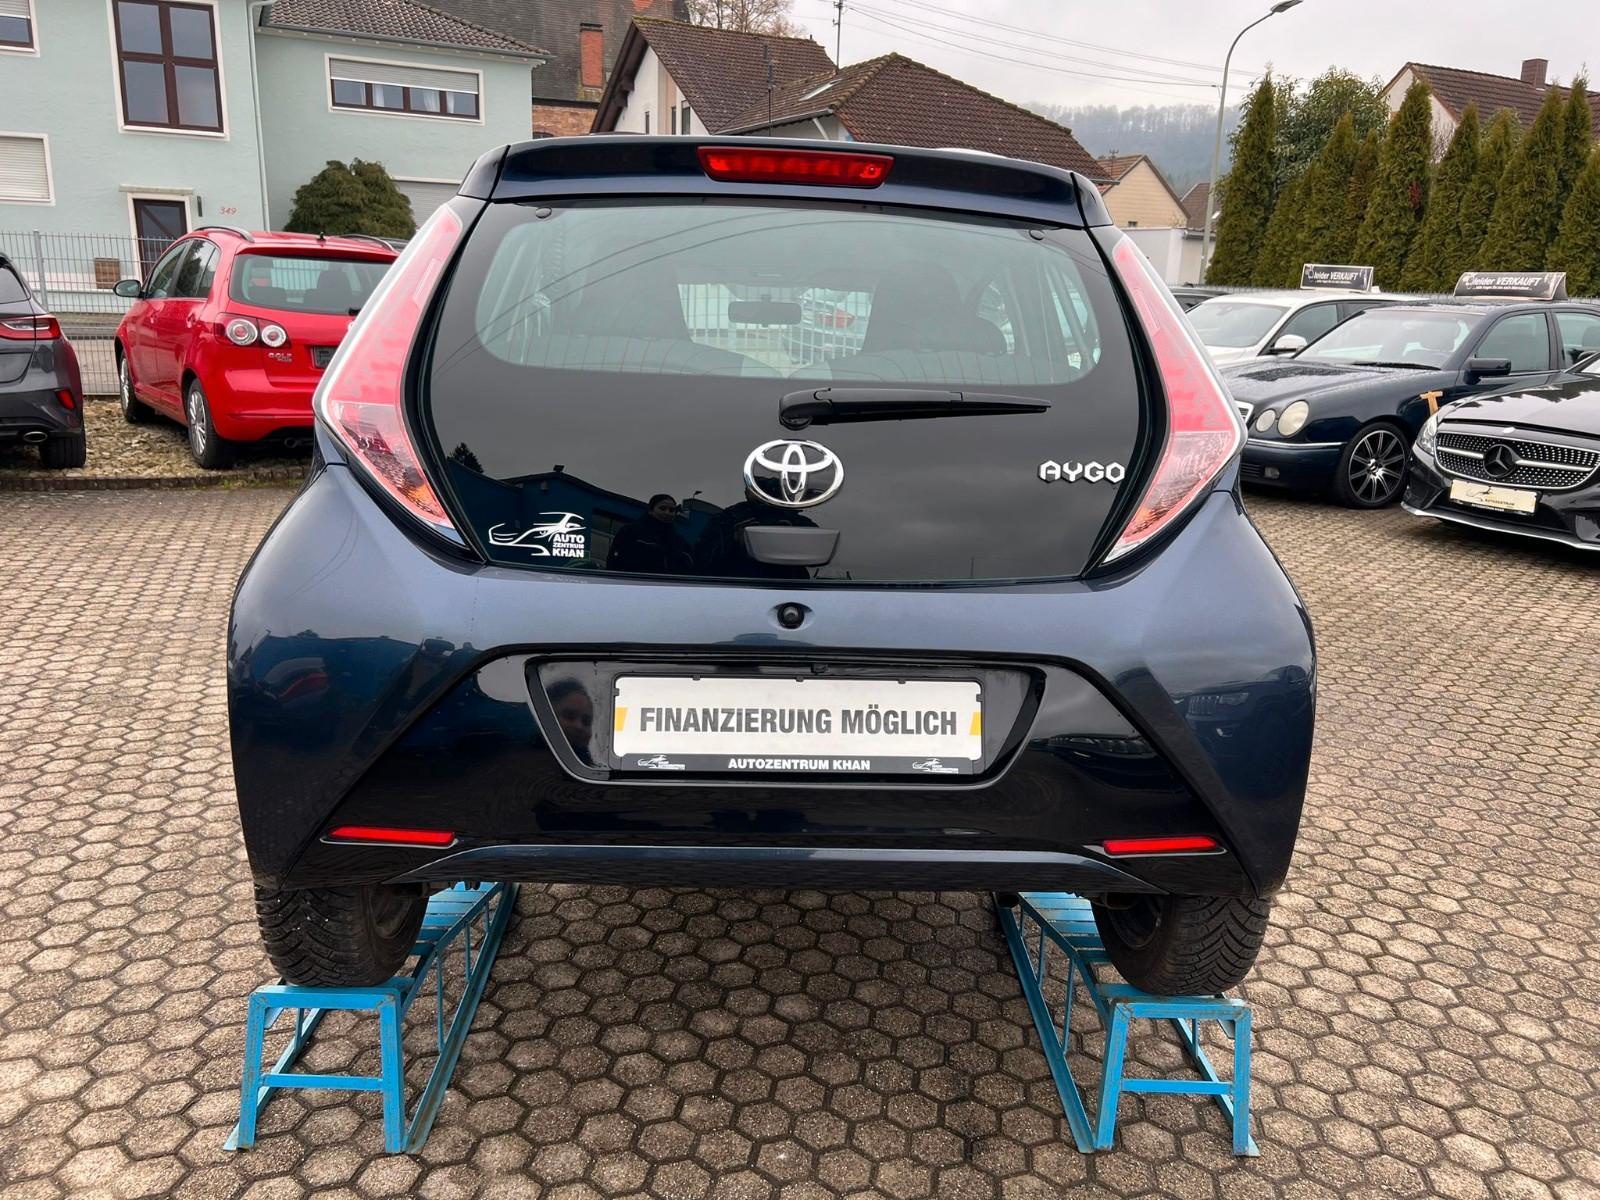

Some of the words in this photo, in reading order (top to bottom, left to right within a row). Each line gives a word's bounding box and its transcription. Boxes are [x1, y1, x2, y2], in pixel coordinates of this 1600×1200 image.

[219, 206, 237, 215] 349
[1330, 271, 1358, 281] VERKAUFT
[1496, 276, 1542, 287] VERKAUFT
[1039, 460, 1125, 483] AYGO
[553, 534, 585, 543] AUTO
[552, 548, 584, 558] KHAN
[640, 707, 832, 734] FINANZIERUNG
[841, 704, 957, 736] MÖGLICH
[728, 758, 830, 771] AUTOZENTRUM
[833, 759, 870, 771] KHAN
